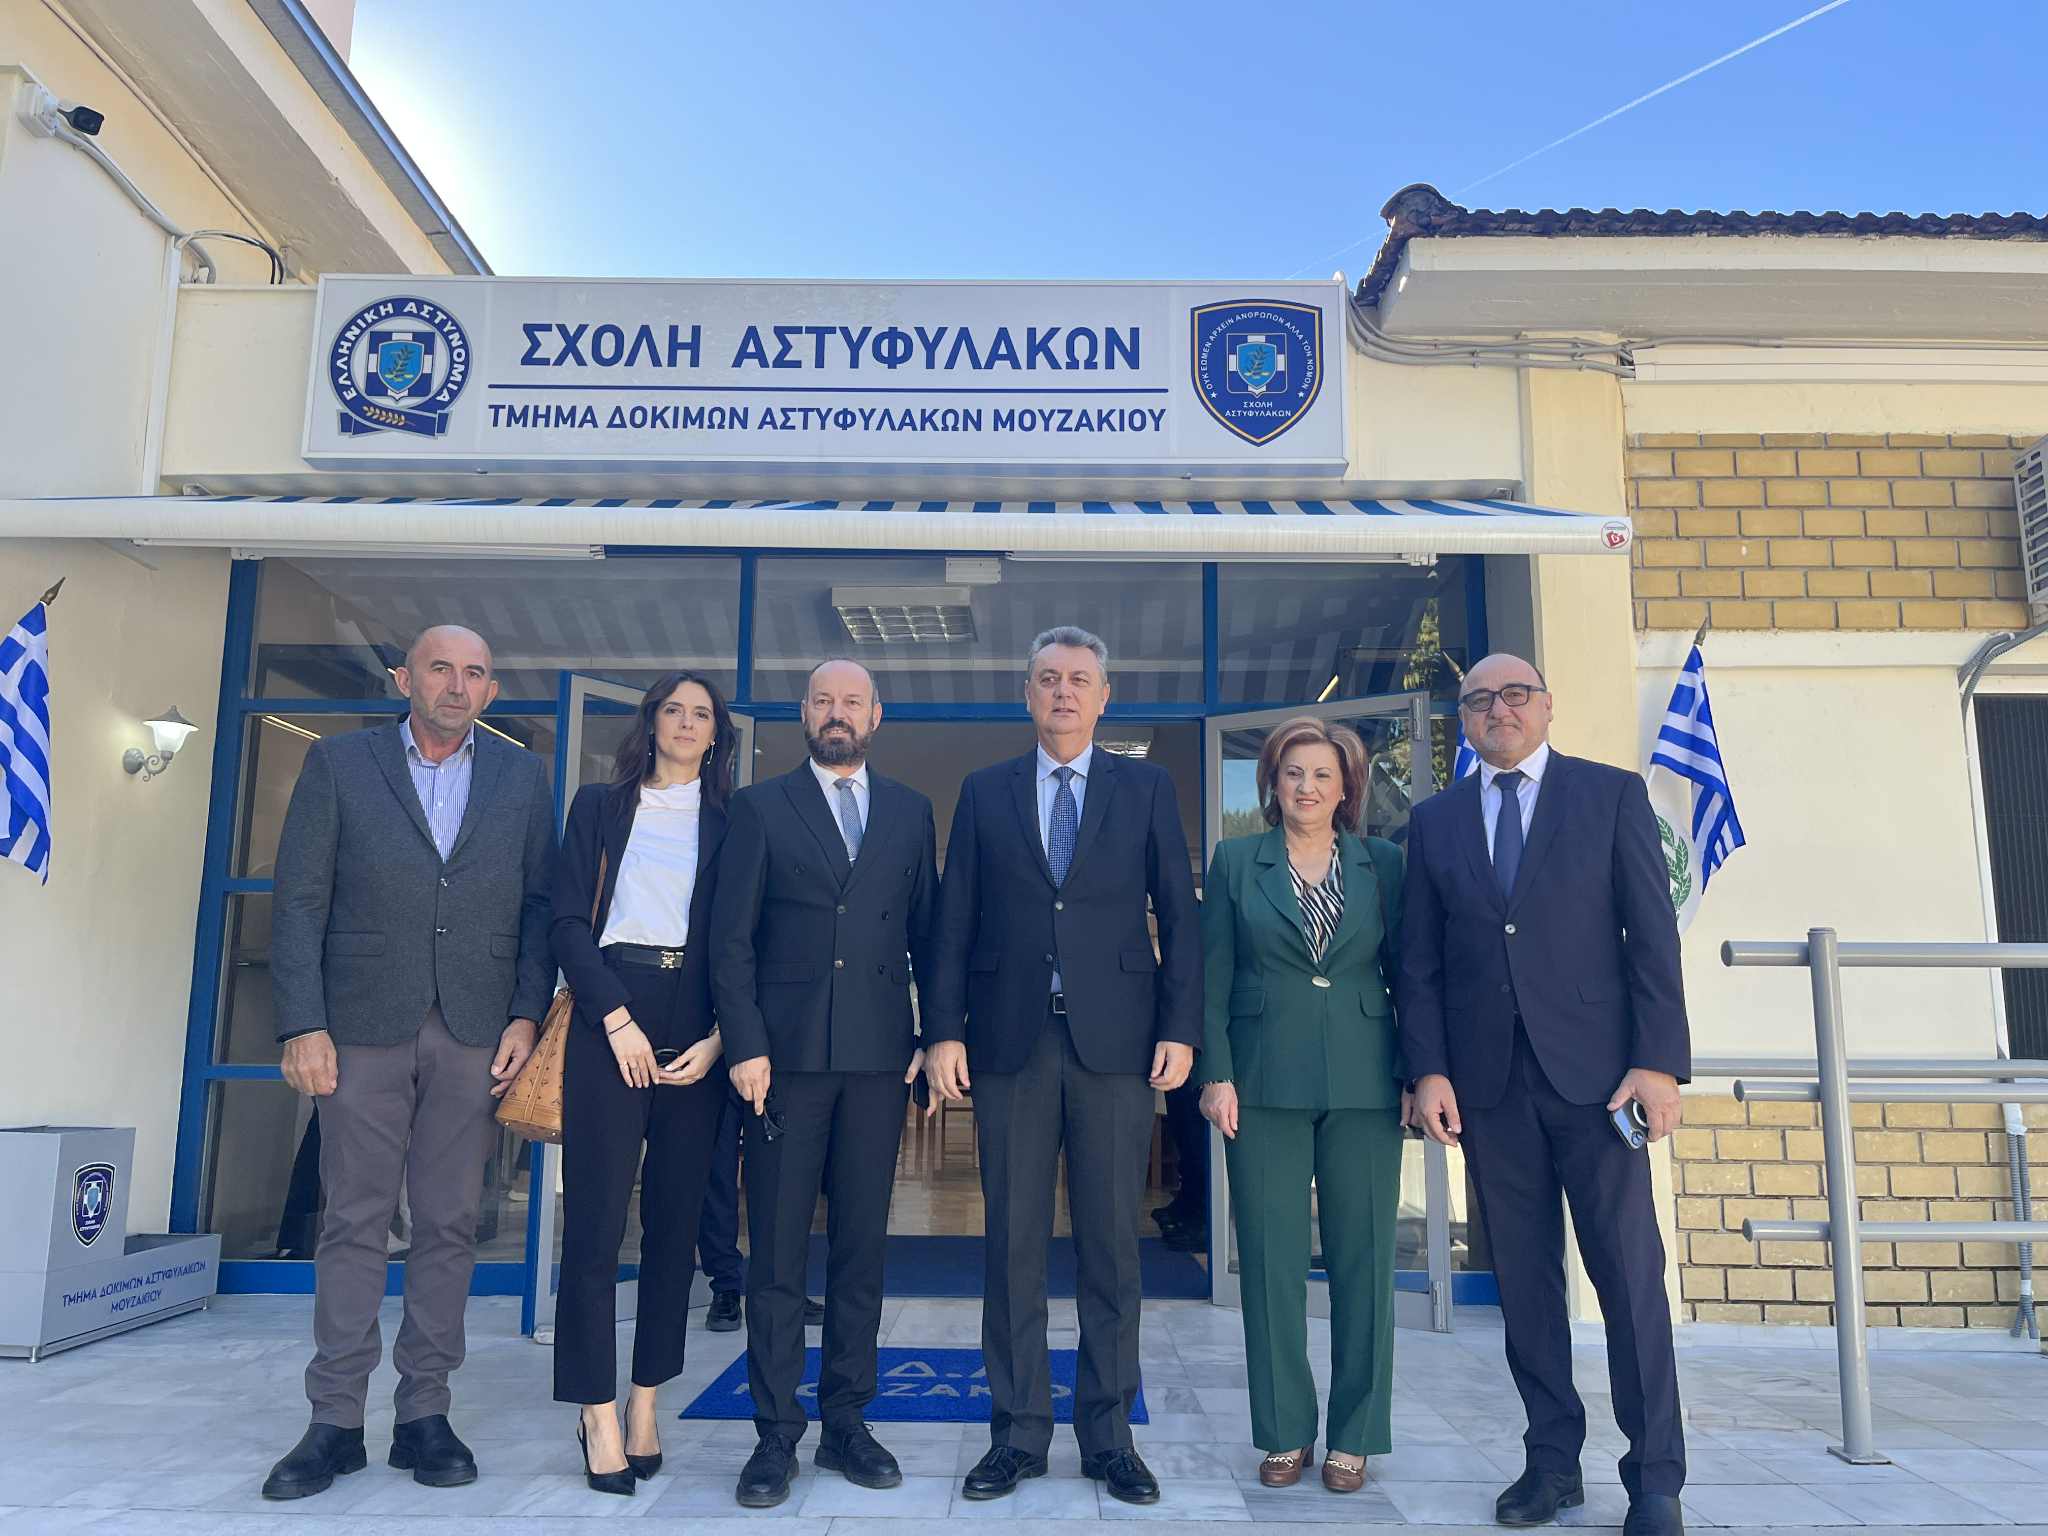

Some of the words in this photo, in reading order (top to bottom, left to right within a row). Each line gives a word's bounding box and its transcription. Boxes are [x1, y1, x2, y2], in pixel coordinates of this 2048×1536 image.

[336, 302, 394, 400] ΕΛΛΗΝΙΚΗ
[403, 301, 466, 402] ΑΣΤΥΝΟΜΙΑ
[519, 322, 702, 368] ΣΧΟΛΗ
[730, 325, 1140, 371] ΑΣΤΥΦΥΛΑΚΩΝ
[488, 404, 599, 429] ΤΜΗΜΑ
[606, 405, 749, 430] ΔΟΚΙΜΩΝ
[757, 407, 983, 433] ΑΣΤΥΦΥΛΑΚΩΝ
[993, 408, 1167, 433] ΜΟΥΖΑΚΙΟΥ
[62, 1290, 97, 1307] ΤΜΗΜΑ
[99, 1277, 143, 1298] ΔΟΚΙΜΩΝ
[145, 1260, 206, 1286] ΑΣΤΥΦΥΛΑΚΩΝ
[110, 1289, 162, 1313] ΜΟΥΖΑΚΙΟΥ
